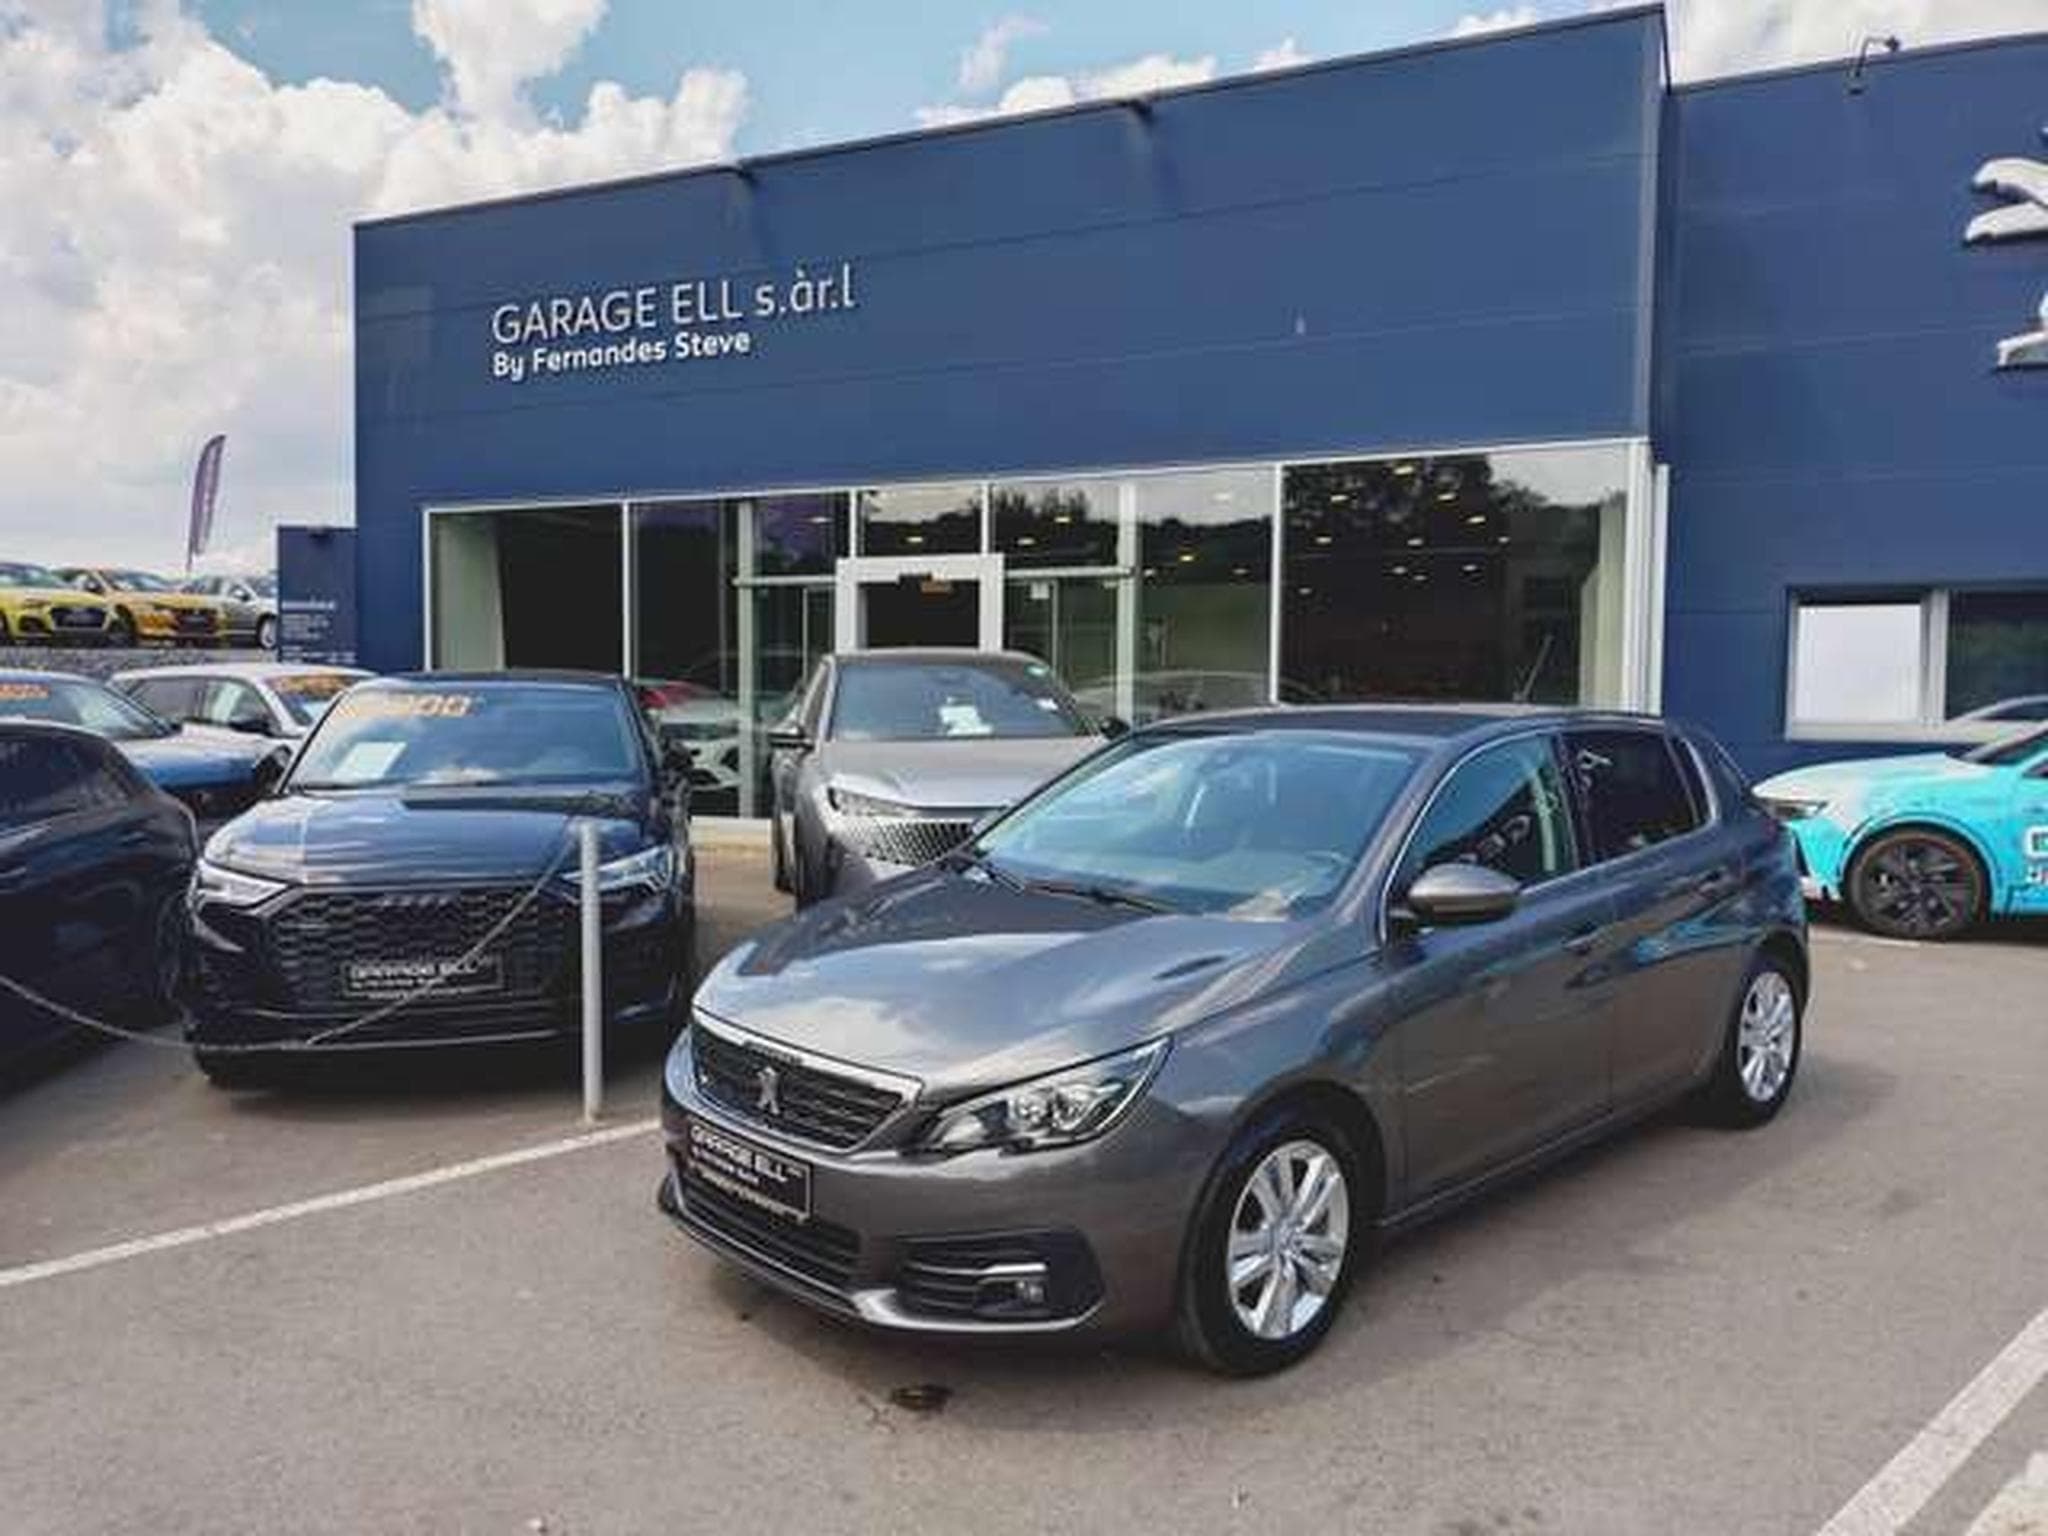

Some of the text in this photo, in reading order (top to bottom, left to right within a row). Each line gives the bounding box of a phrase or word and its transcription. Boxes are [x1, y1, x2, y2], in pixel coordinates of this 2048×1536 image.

[492, 286, 657, 344] GARAGE
[672, 280, 743, 325] ELL
[493, 328, 751, 382] By Fernandes Steve
